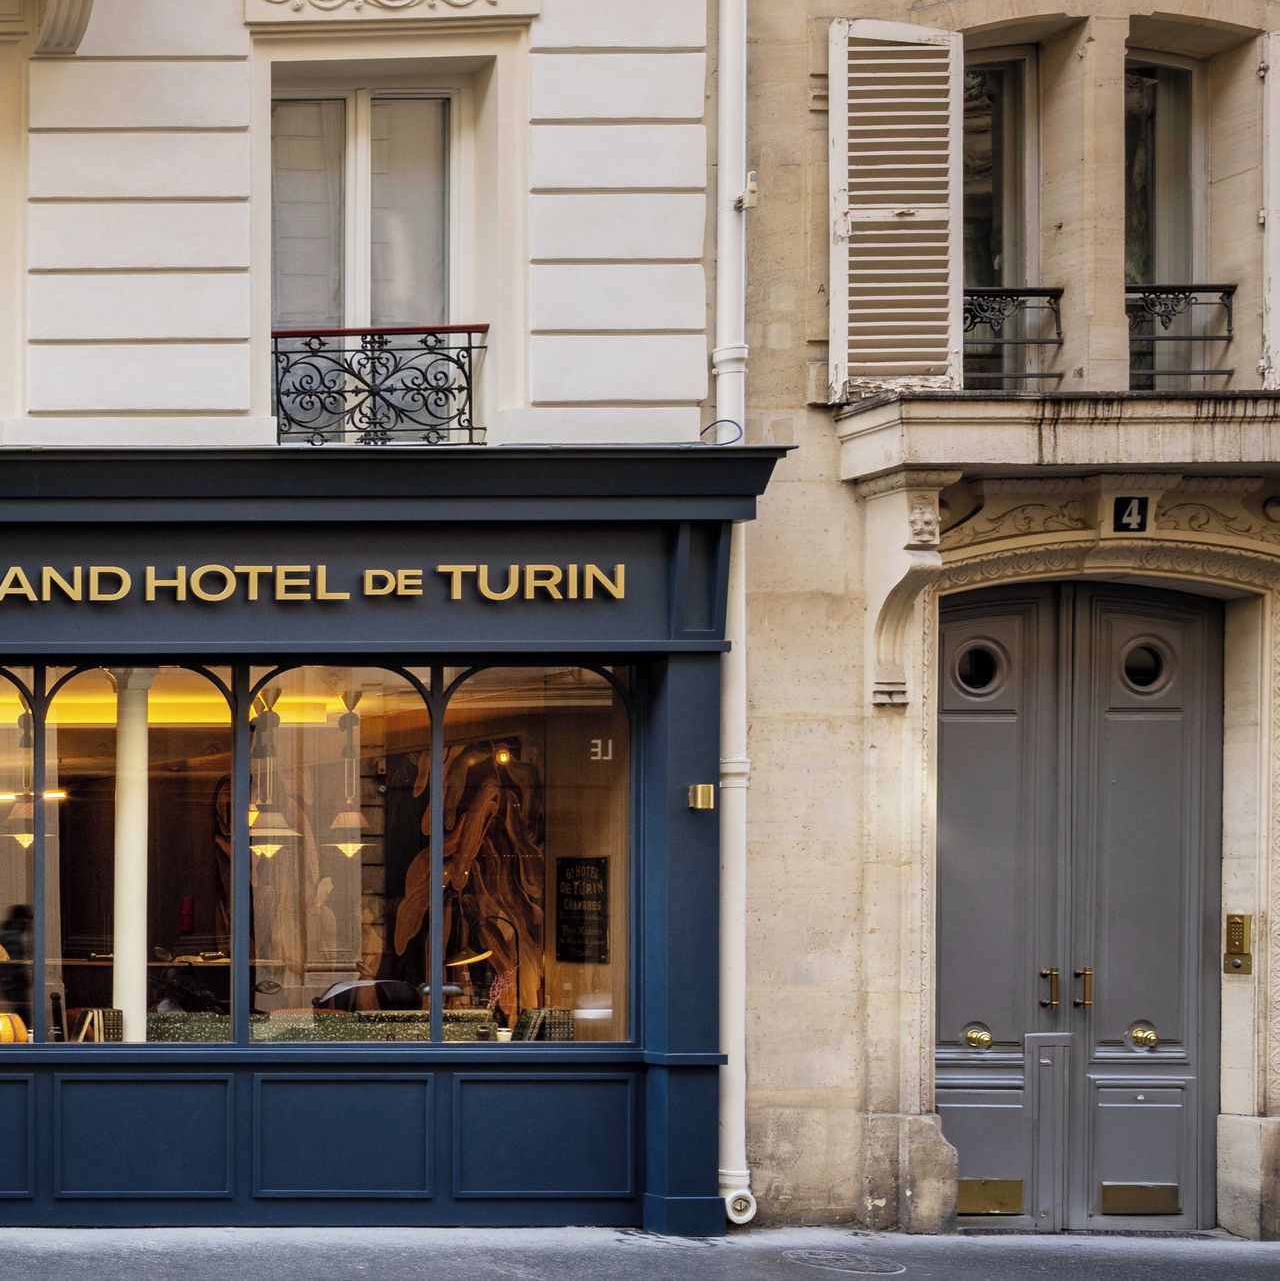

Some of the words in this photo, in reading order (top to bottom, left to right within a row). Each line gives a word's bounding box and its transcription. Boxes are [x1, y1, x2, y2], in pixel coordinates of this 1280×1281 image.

[1122, 499, 1141, 529] 4
[145, 564, 351, 602] HOTEL
[364, 569, 423, 597] DE
[437, 563, 625, 601] TURIN
